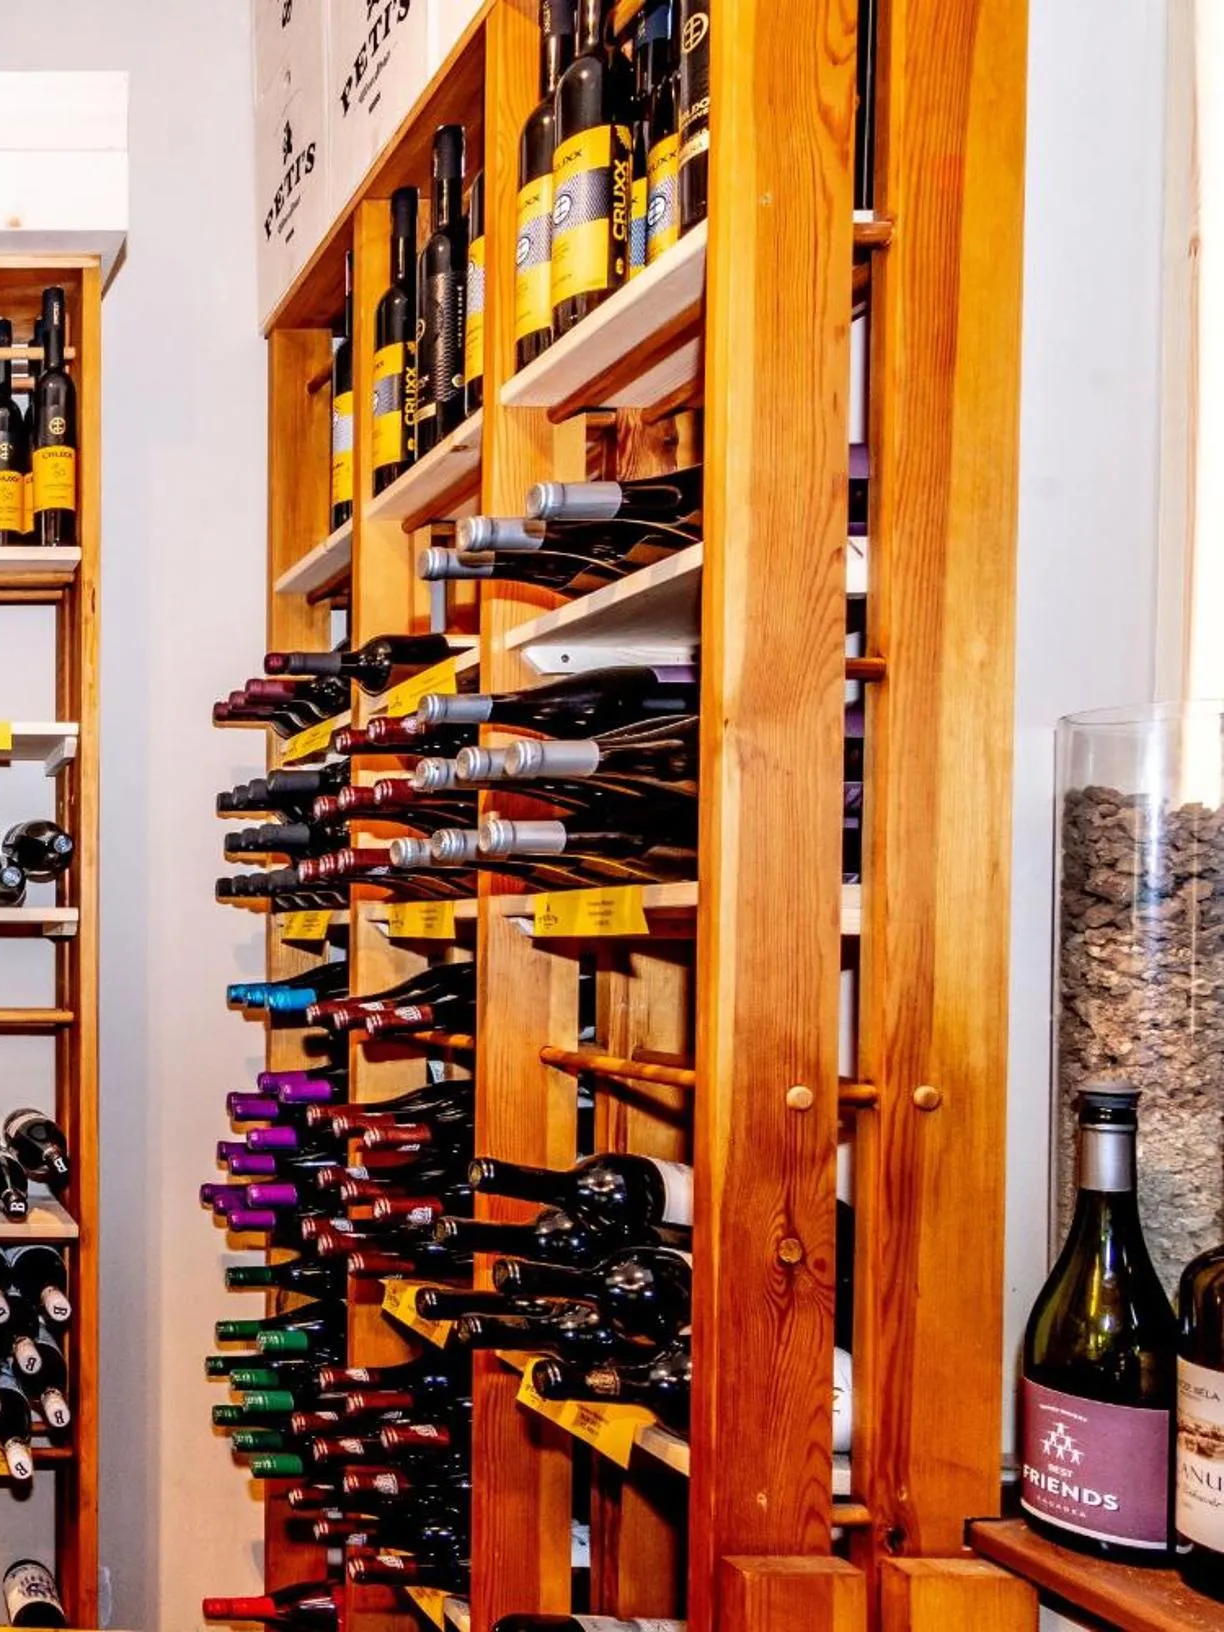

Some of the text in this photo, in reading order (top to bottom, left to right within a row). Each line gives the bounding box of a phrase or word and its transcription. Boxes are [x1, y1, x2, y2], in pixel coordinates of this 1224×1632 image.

[612, 159, 627, 241] CRUXX
[404, 366, 418, 426] CRUXX
[1022, 1463, 1119, 1512] FRIENDS
[1047, 1463, 1074, 1478] BEST
